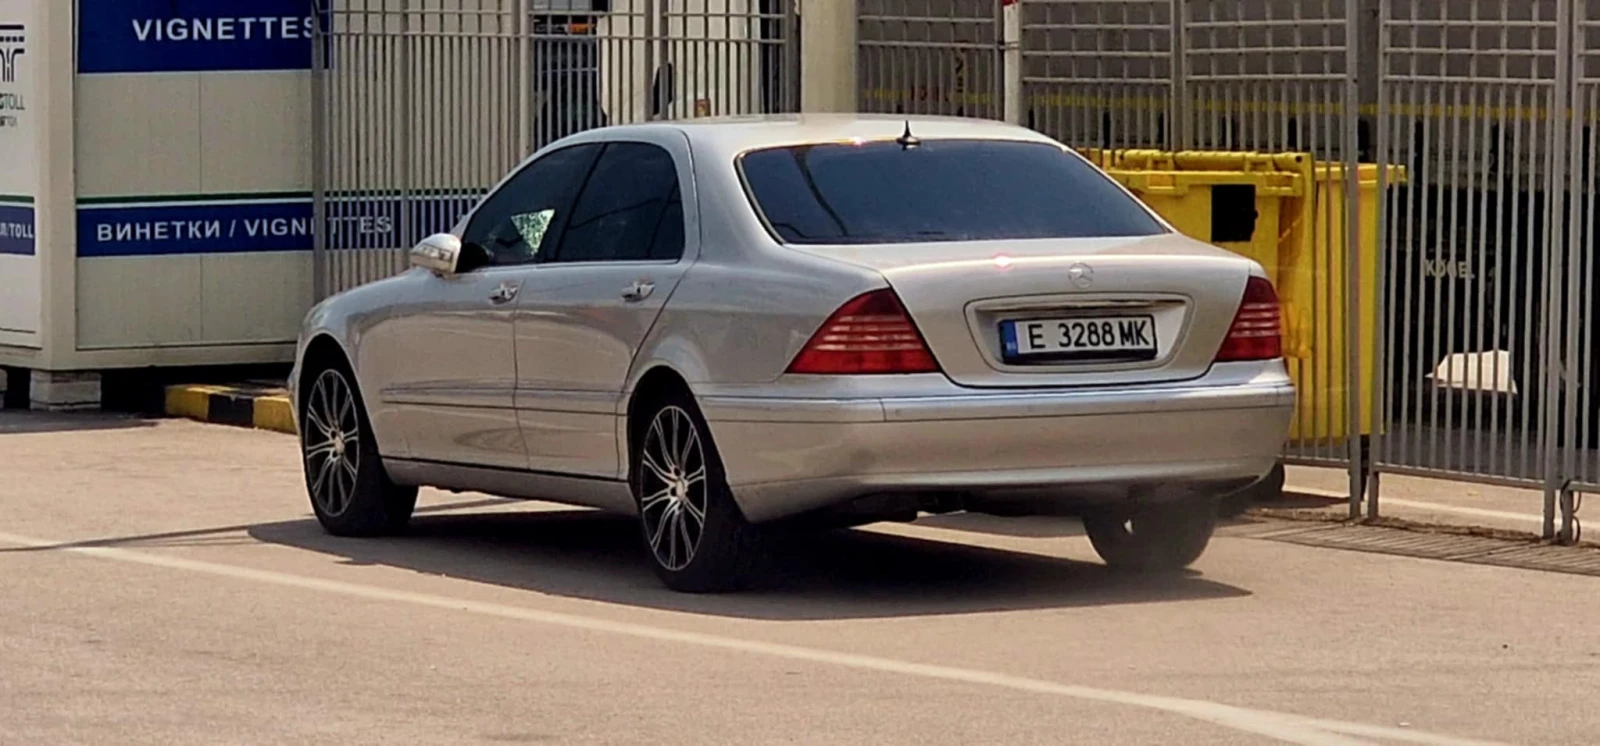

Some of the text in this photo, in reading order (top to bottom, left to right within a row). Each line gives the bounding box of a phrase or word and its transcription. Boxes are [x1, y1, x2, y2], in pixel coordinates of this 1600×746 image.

[132, 16, 313, 41] VIGNETTES
[97, 220, 220, 242] ВИНЕТКИ
[244, 215, 392, 237] VIGNTTES
[1028, 320, 1150, 349] E 3288 MK
